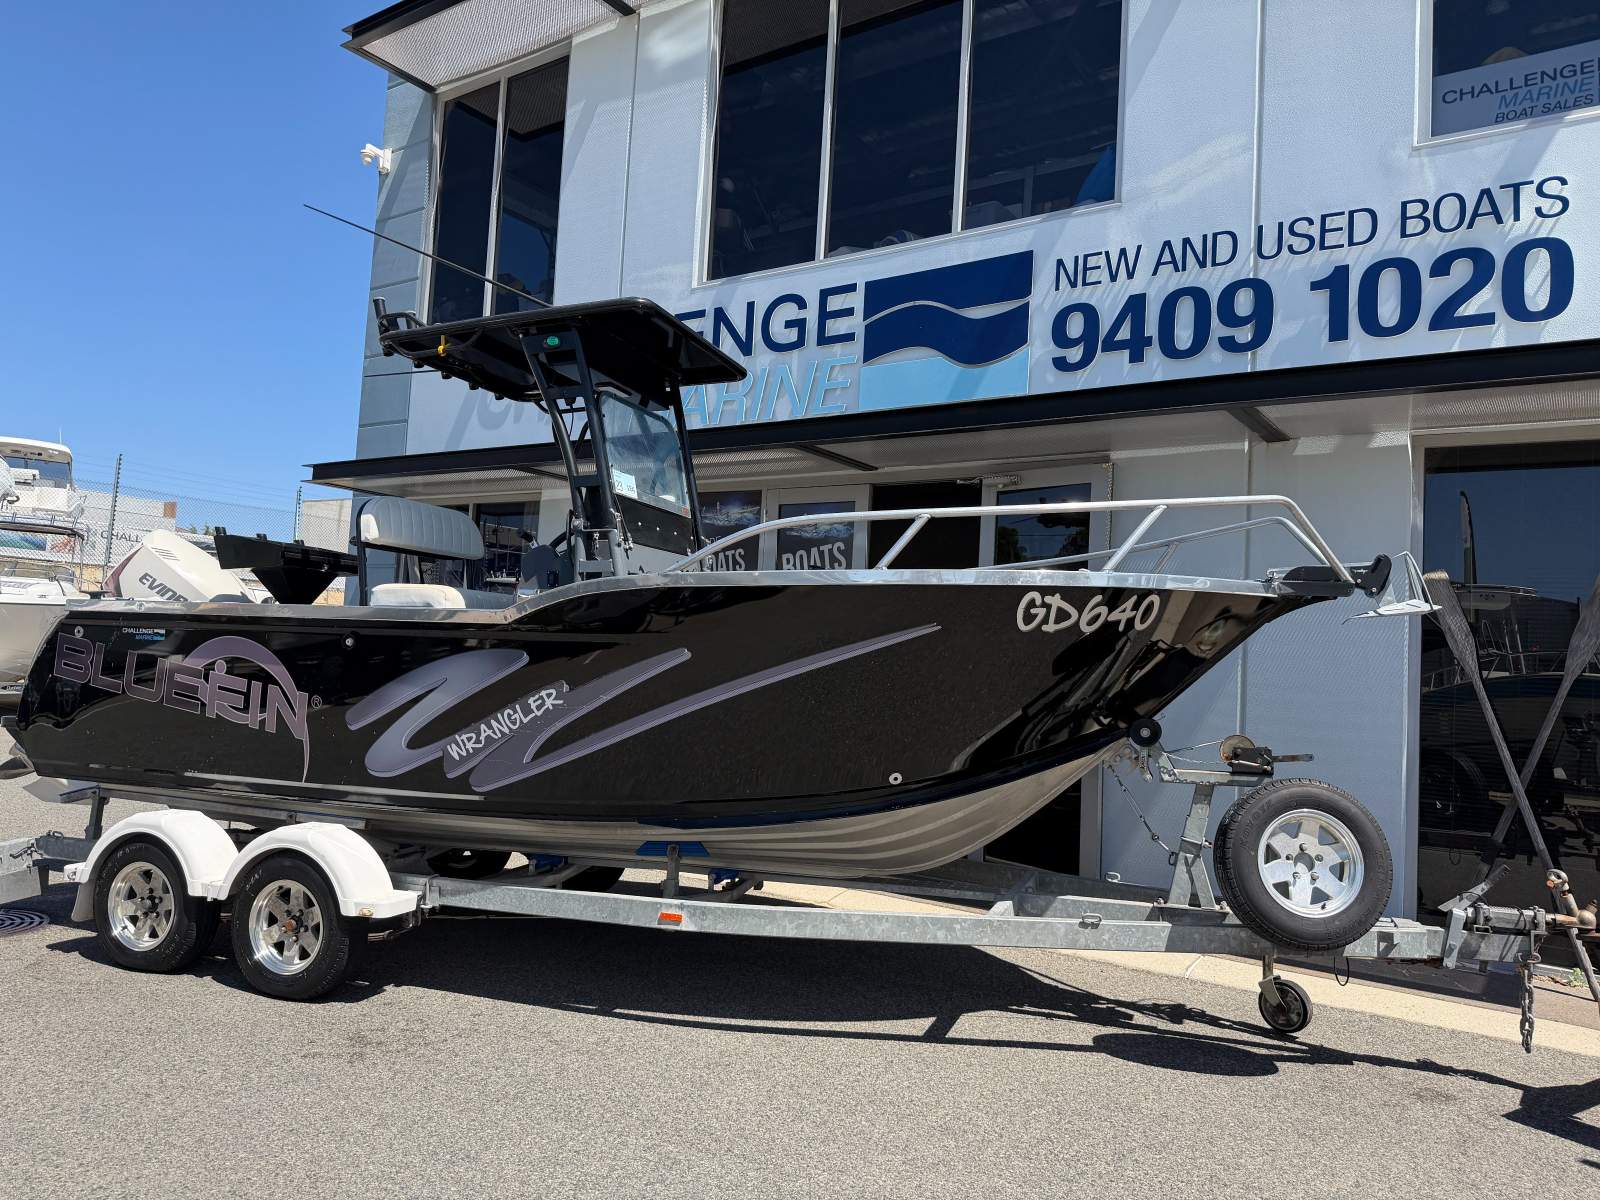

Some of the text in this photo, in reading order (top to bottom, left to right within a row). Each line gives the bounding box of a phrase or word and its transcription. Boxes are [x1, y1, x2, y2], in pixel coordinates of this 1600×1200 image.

[1442, 59, 1595, 104] CHALLENGE
[1498, 75, 1595, 110] MARINE
[1494, 93, 1595, 124] BOAT SALES
[1054, 175, 1570, 292] NEW AND USED BOATS
[1051, 236, 1575, 373] 9409 1020
[781, 541, 847, 571] BOATS
[122, 627, 155, 635] CHALLENGE
[1016, 590, 1161, 633] GD640
[446, 687, 565, 761] WRANGLER
